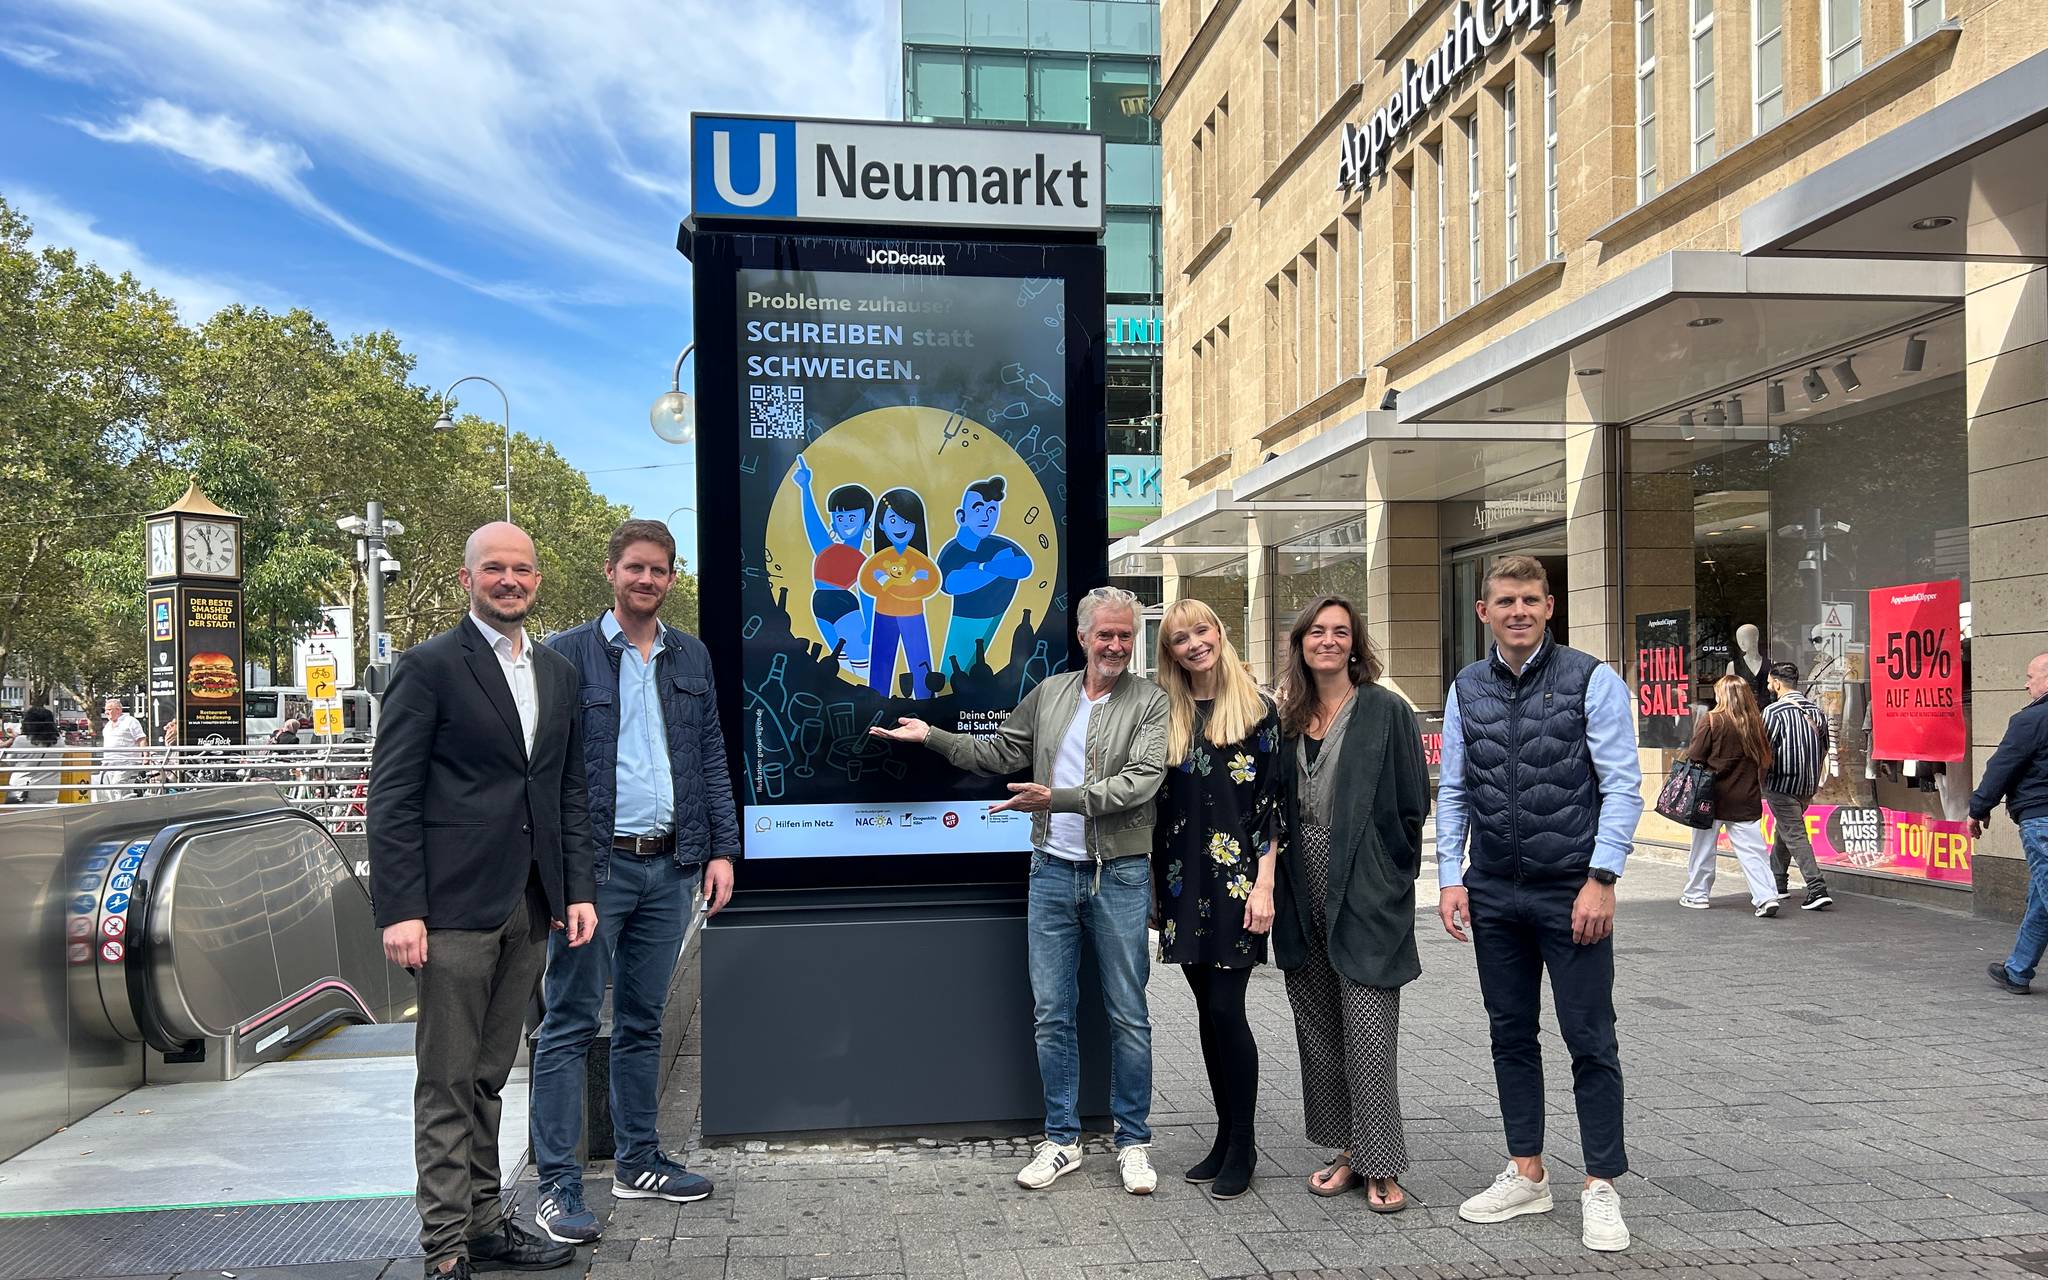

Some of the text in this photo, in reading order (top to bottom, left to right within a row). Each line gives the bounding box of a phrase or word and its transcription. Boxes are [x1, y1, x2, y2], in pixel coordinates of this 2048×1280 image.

[713, 130, 1089, 208] U Neumarkt
[866, 249, 946, 267] JCDecaux
[747, 291, 851, 312] Probleme
[747, 321, 975, 348] SCHREIBEN statt
[747, 356, 921, 381] SCHWEIGEN.
[190, 598, 233, 607] DER BESTE
[191, 605, 232, 614] SMASHED
[206, 620, 236, 628] STADT!
[1876, 628, 1951, 680] -50%
[1639, 645, 1689, 682] FINAL
[1640, 683, 1690, 716] SALE
[1886, 687, 1953, 708] AUF ALLES
[959, 710, 986, 720] Deine
[957, 721, 999, 731] Bei Sucht
[775, 818, 834, 829] Hilfen im Netz
[1839, 809, 1878, 825] ALLES
[1841, 824, 1878, 840] MUSS
